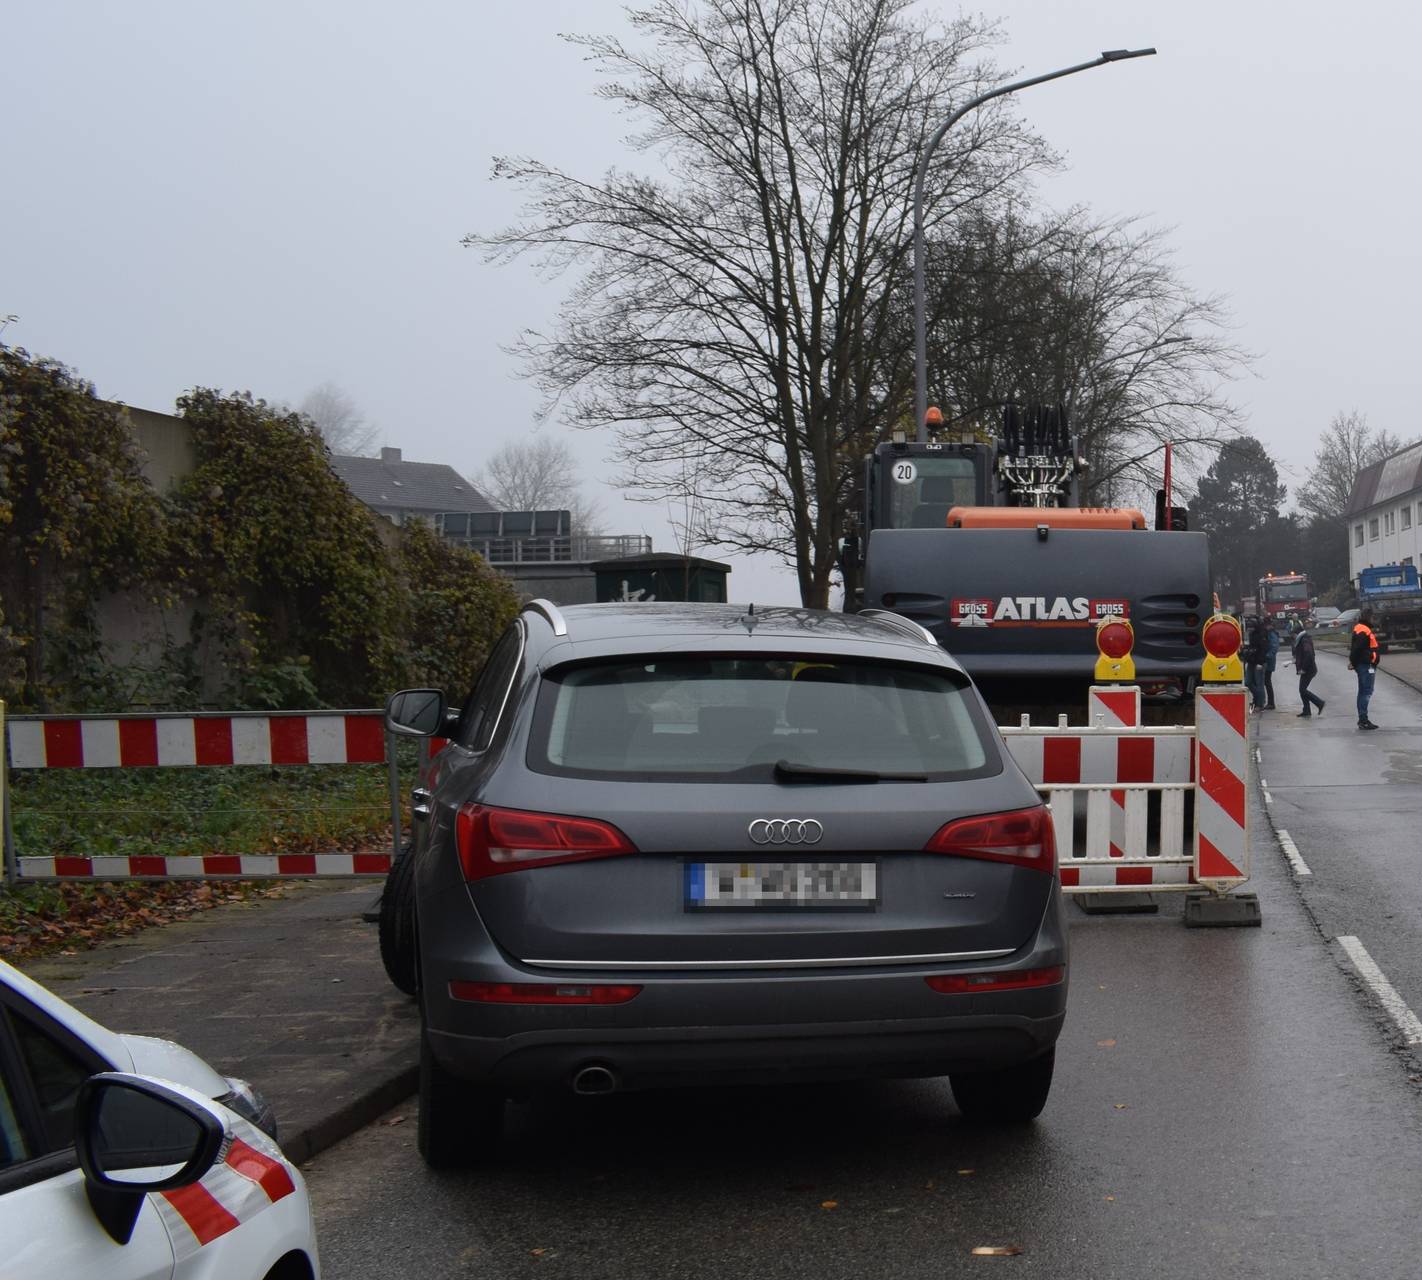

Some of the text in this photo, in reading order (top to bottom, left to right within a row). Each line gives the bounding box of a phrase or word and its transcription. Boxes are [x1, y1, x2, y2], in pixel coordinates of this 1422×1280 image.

[897, 465, 912, 480] 20
[959, 596, 1124, 620] GROSS ATLAS GROSS
